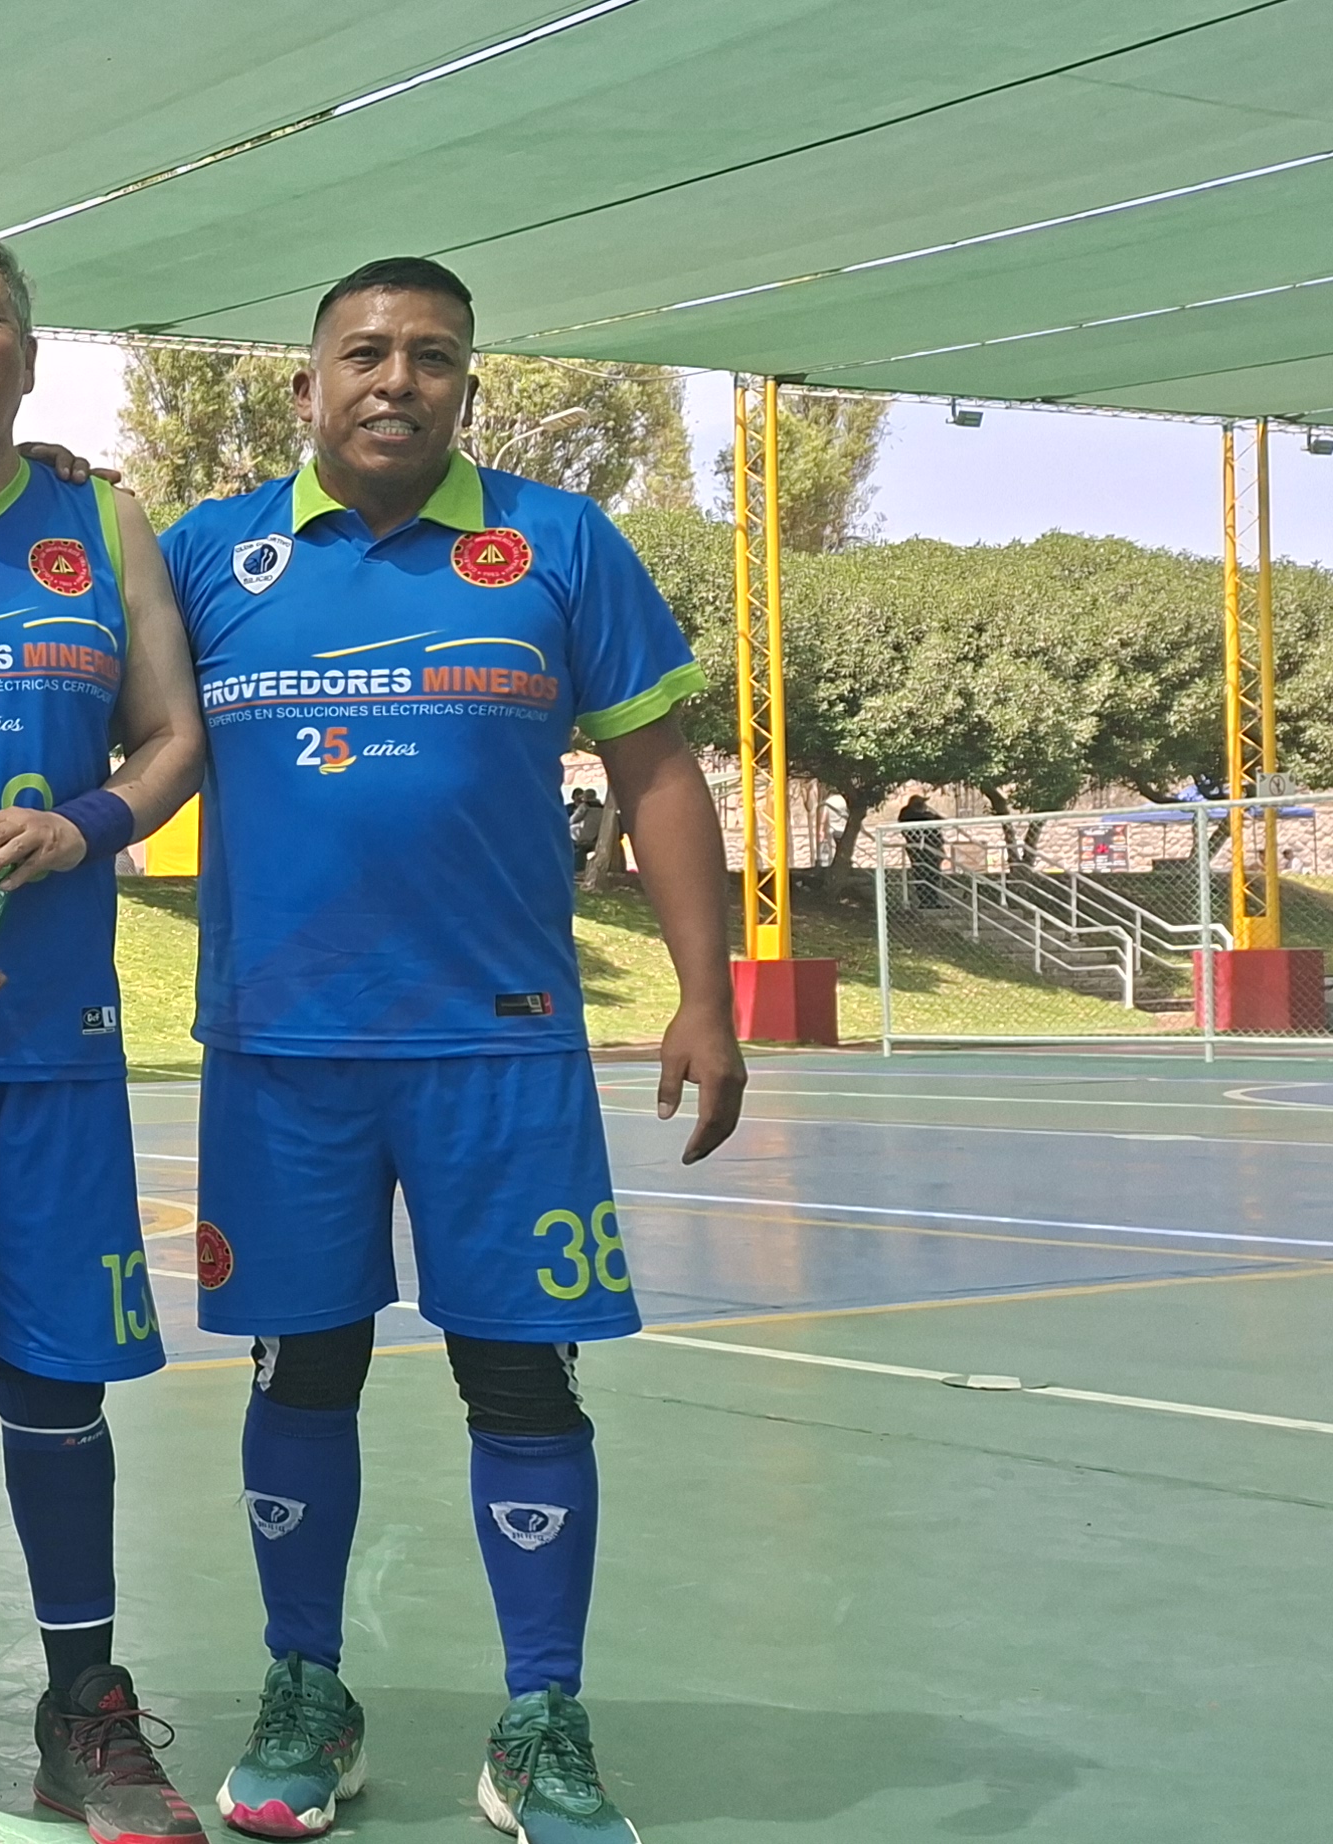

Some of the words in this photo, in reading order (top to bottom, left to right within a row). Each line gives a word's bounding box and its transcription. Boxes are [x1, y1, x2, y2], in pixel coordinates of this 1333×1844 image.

[203, 667, 412, 708] PROVEEDORES
[422, 665, 558, 700] MINEROS
[208, 709, 252, 728] EXPERTOS
[255, 707, 273, 719] EN
[276, 703, 369, 718] SOLUCIONES
[373, 701, 464, 716] ELÉCTRICAS
[296, 726, 349, 766] 25
[363, 739, 420, 758] años
[533, 1200, 631, 1300] 38
